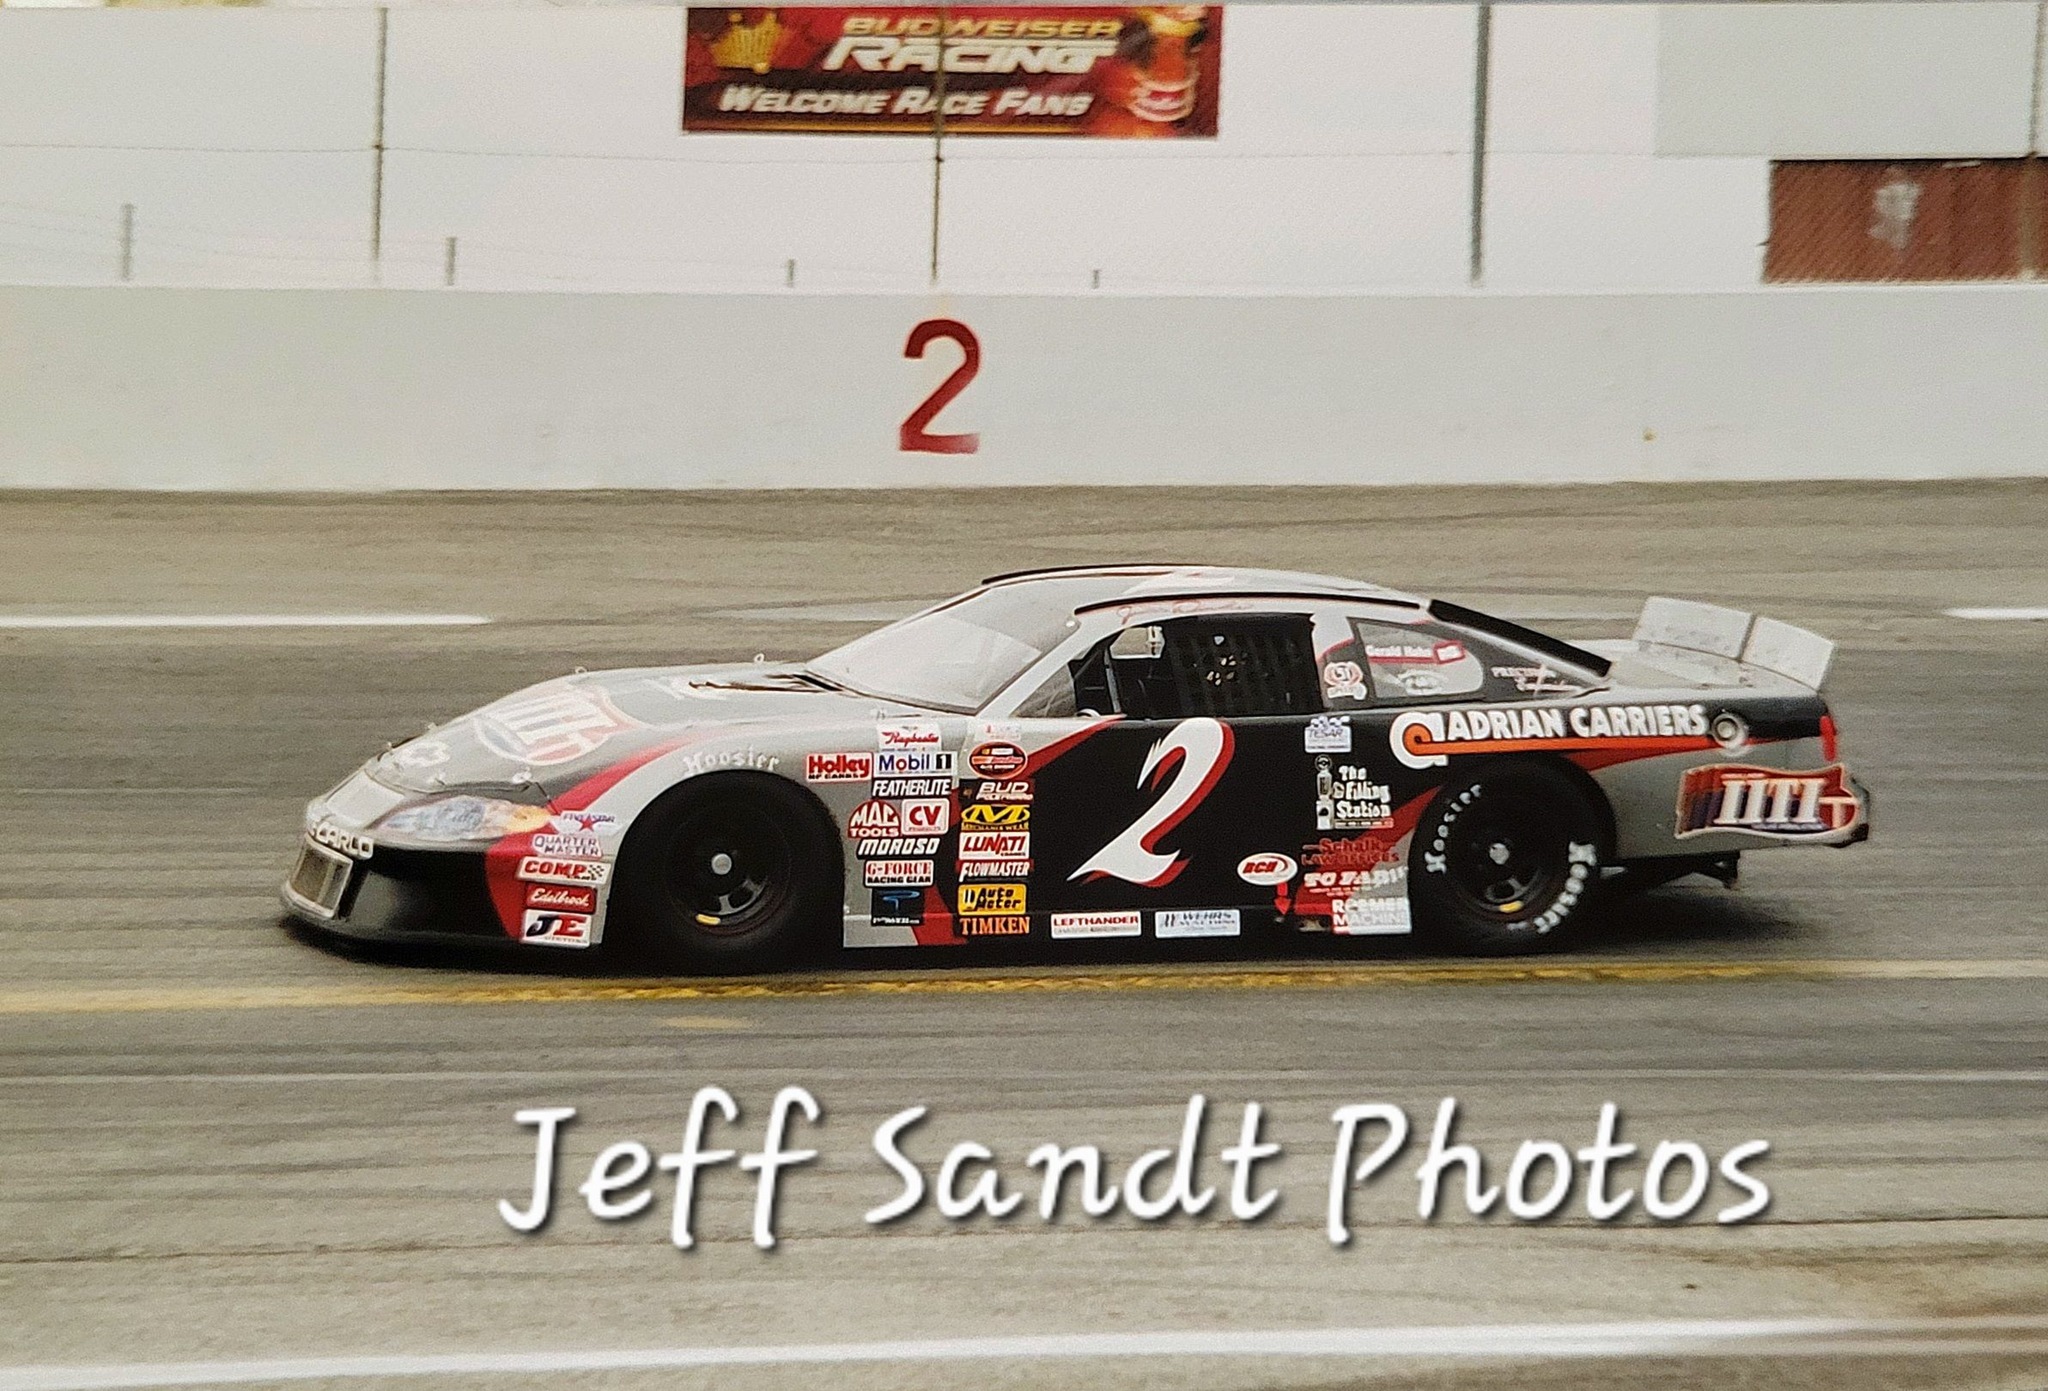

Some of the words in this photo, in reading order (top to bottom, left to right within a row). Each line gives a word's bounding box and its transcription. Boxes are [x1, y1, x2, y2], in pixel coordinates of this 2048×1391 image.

[842, 17, 1122, 36] BUDWEISER
[822, 36, 1119, 73] RACING
[718, 85, 892, 114] WELCOME
[891, 86, 991, 115] RACE
[993, 87, 1095, 116] FANS
[900, 319, 980, 454] 2
[1447, 708, 1567, 741] ADRIAN
[1570, 704, 1709, 738] CARRIERS
[808, 754, 870, 778] Holley
[879, 753, 930, 771] Mobil
[1338, 765, 1367, 781] The
[872, 778, 951, 796] FEATHERLITE
[979, 781, 1029, 793] BUD
[1346, 781, 1391, 803] Filling
[1067, 717, 1234, 887] 2
[1337, 800, 1391, 819] Station
[850, 801, 899, 827] MAC
[909, 806, 942, 826] CV
[317, 821, 375, 860] CARLO
[850, 827, 899, 837] TOOLS
[534, 835, 598, 849] QUARTER
[545, 844, 599, 856] MASTER
[858, 837, 941, 856] MOROSO
[963, 833, 1026, 855] LUNATI
[524, 860, 588, 877] COMP
[867, 862, 932, 875] G-FORCE
[959, 861, 1030, 882] FLOWMASTER
[531, 887, 590, 907] Edelbrock
[979, 887, 1015, 898] Auto
[526, 914, 588, 937] JE
[960, 916, 1030, 935] TIMKEN
[1053, 915, 1139, 927] LEFTHANDER
